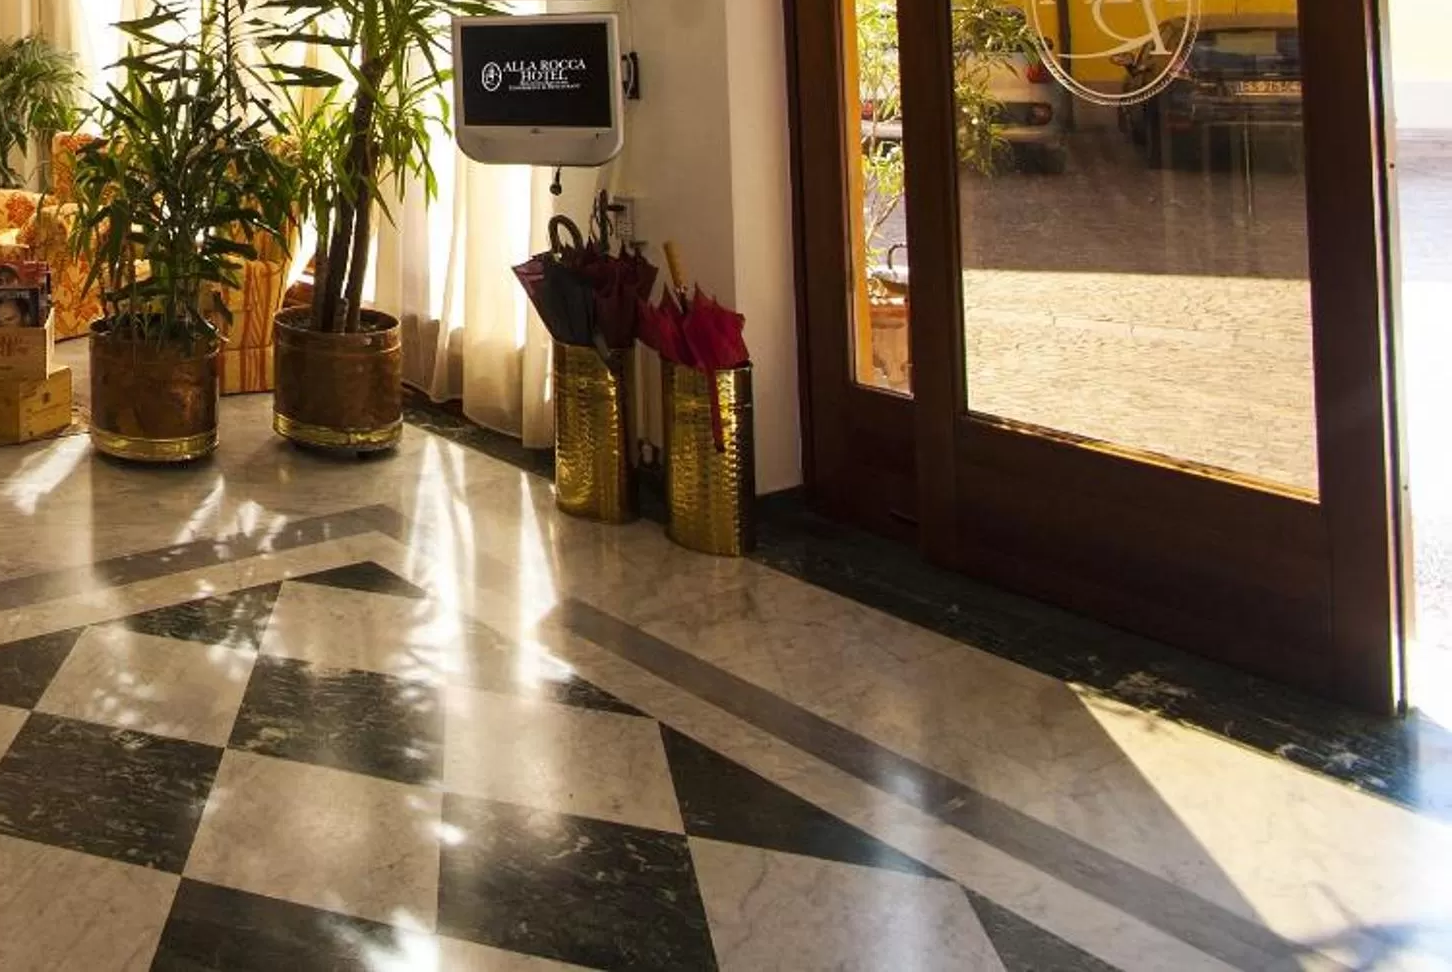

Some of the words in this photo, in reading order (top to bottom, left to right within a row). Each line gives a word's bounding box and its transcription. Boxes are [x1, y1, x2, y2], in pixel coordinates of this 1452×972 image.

[502, 60, 537, 72] ALLA
[539, 58, 586, 70] ROCCA
[521, 68, 568, 81] HOTEL
